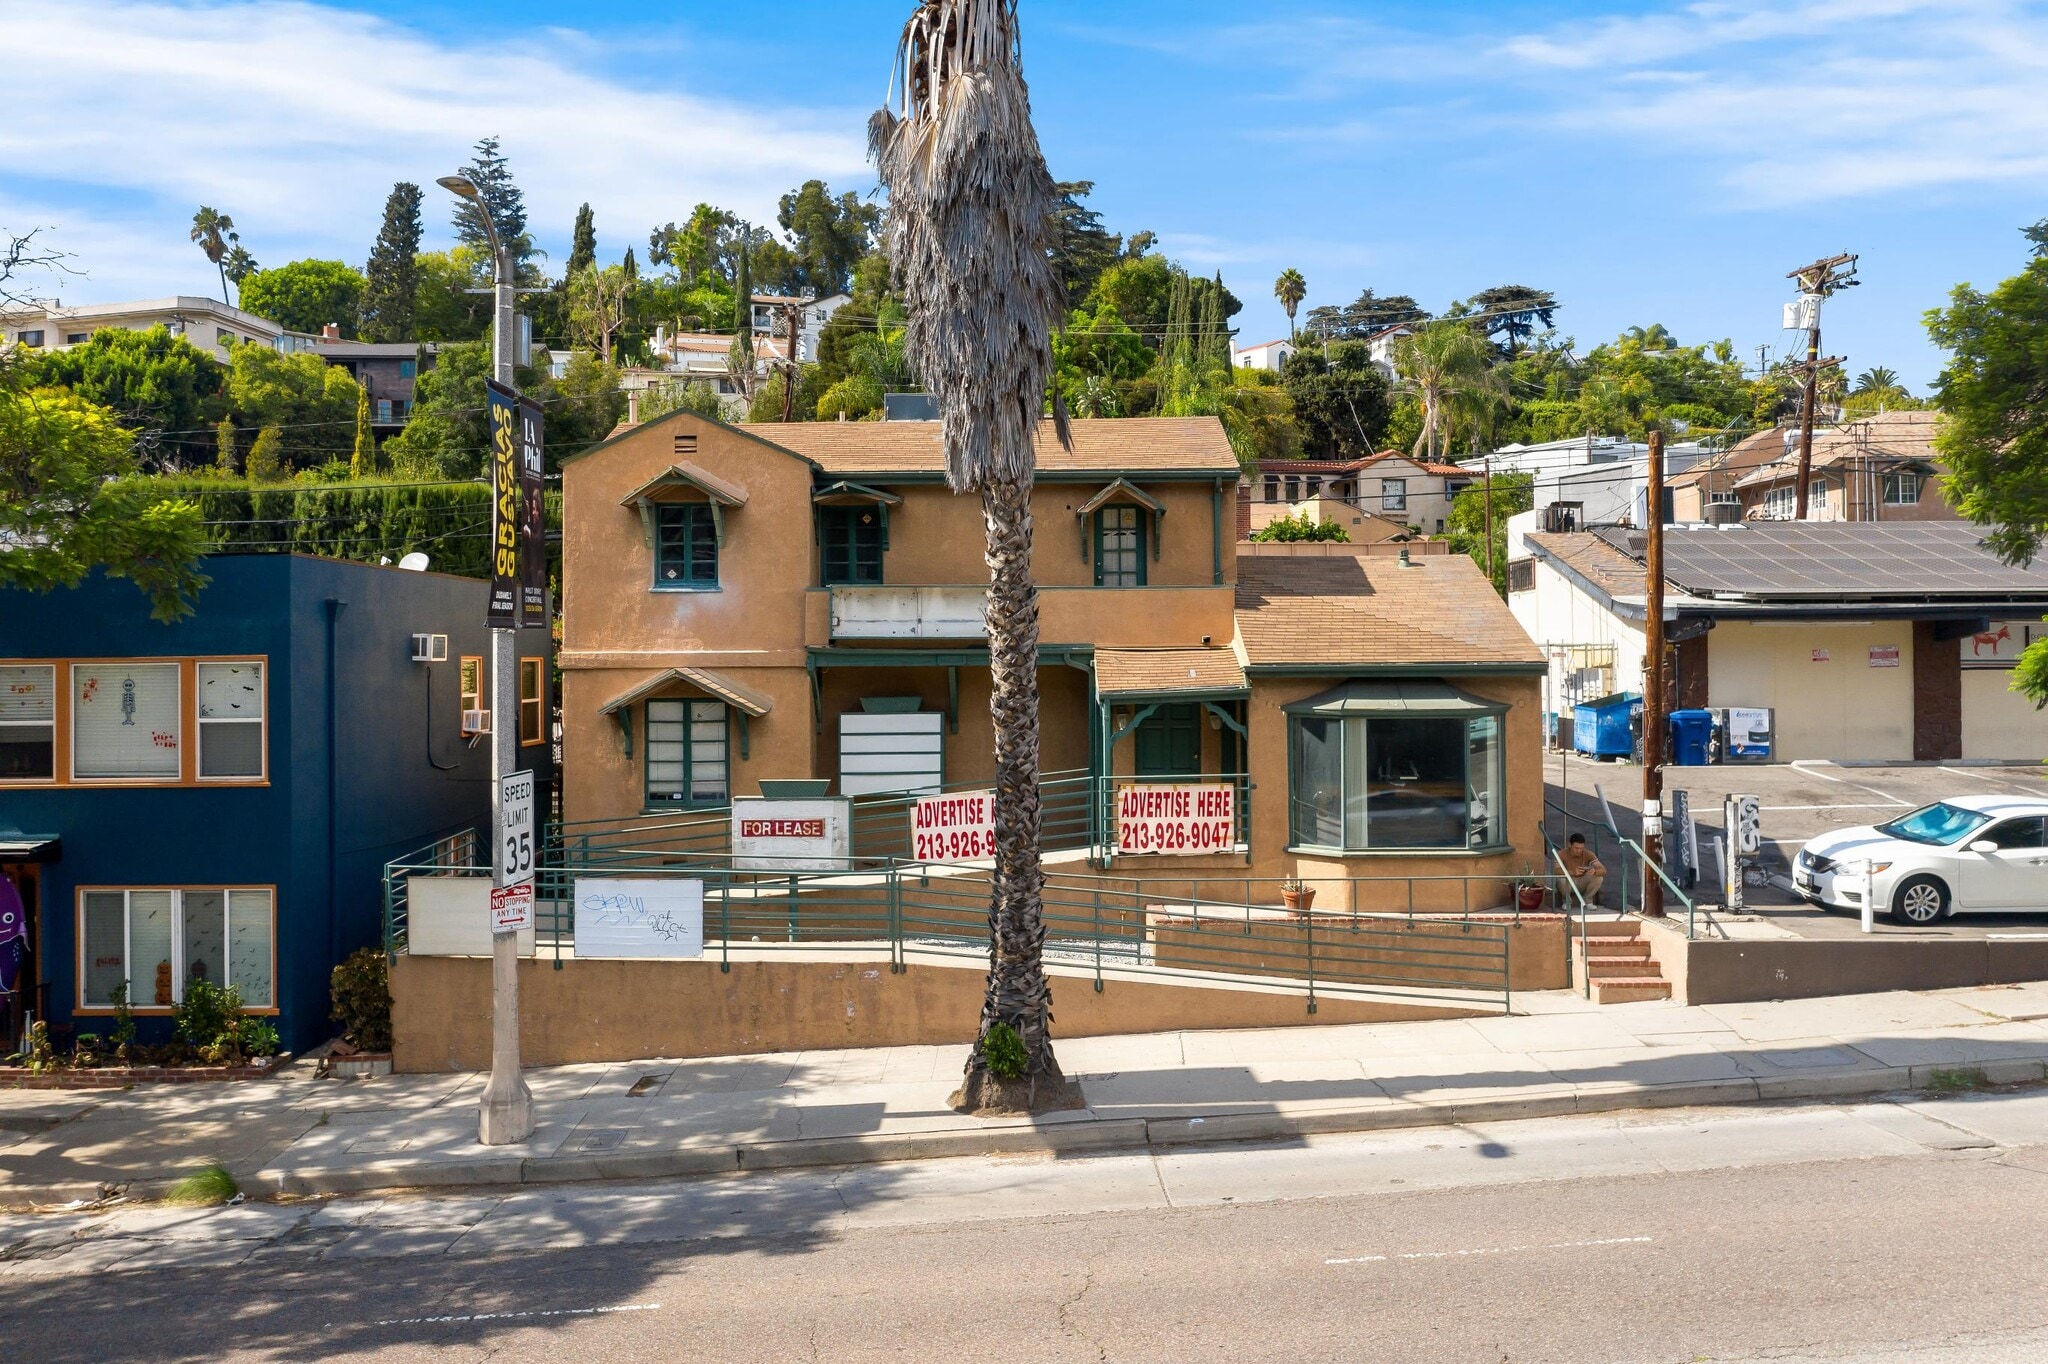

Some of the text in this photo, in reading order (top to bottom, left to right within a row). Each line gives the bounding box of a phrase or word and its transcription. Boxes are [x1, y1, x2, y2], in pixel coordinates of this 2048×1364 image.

[524, 417, 536, 445] LA
[524, 444, 541, 473] Phil
[492, 402, 507, 577] GRACIAS
[503, 407, 516, 578] GUSTAVO
[504, 781, 531, 803] SPEED
[1122, 791, 1231, 818] ADVERTISE HERE
[507, 807, 528, 828] LIMIT
[916, 798, 984, 829] ADVERTISE
[743, 821, 821, 836] FOR LEASE
[1122, 821, 1230, 849] 213-926-9047
[505, 831, 531, 876] 35
[492, 895, 530, 909] NO STOPPING
[496, 906, 527, 918] ANY TIME
